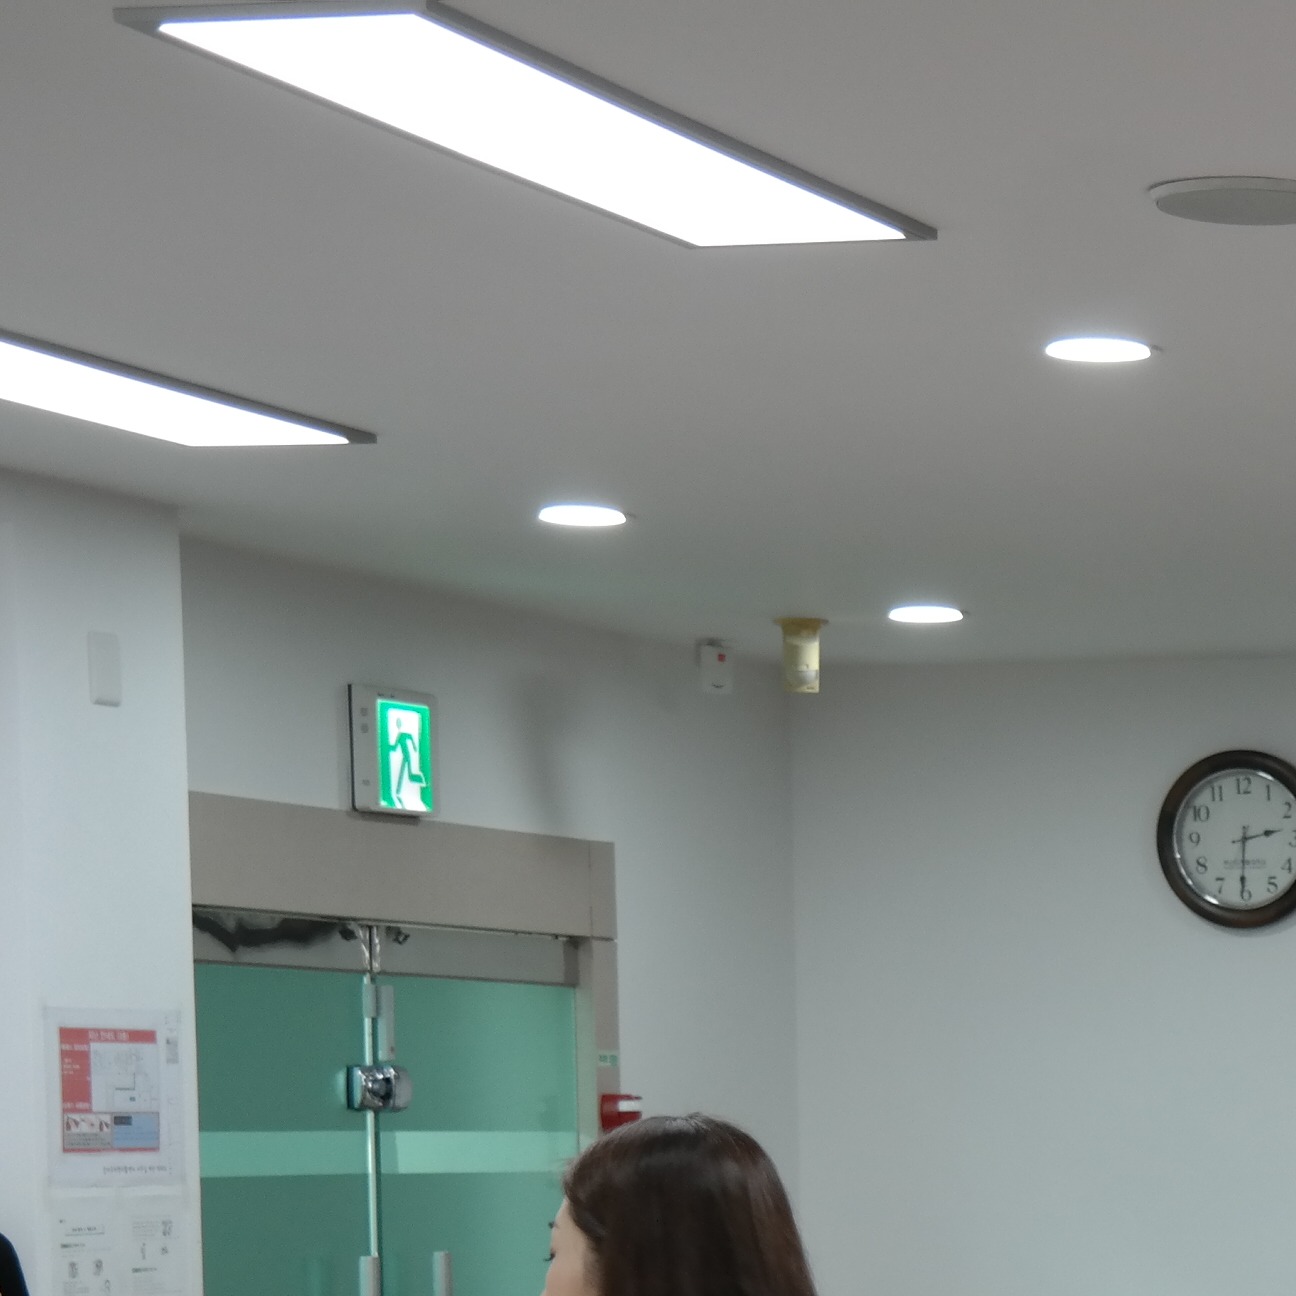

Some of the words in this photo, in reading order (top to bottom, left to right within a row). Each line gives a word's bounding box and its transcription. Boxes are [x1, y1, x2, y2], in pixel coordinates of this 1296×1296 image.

[1210, 785, 1223, 801] 11
[1234, 776, 1252, 794] 12
[1265, 784, 1272, 801] 1
[1192, 804, 1209, 822] 10
[1282, 802, 1292, 819] 2
[1189, 831, 1200, 846] 9
[1196, 856, 1207, 874] 8
[1281, 857, 1292, 874] 4
[1215, 877, 1224, 894] 7
[1266, 876, 1278, 893] 5
